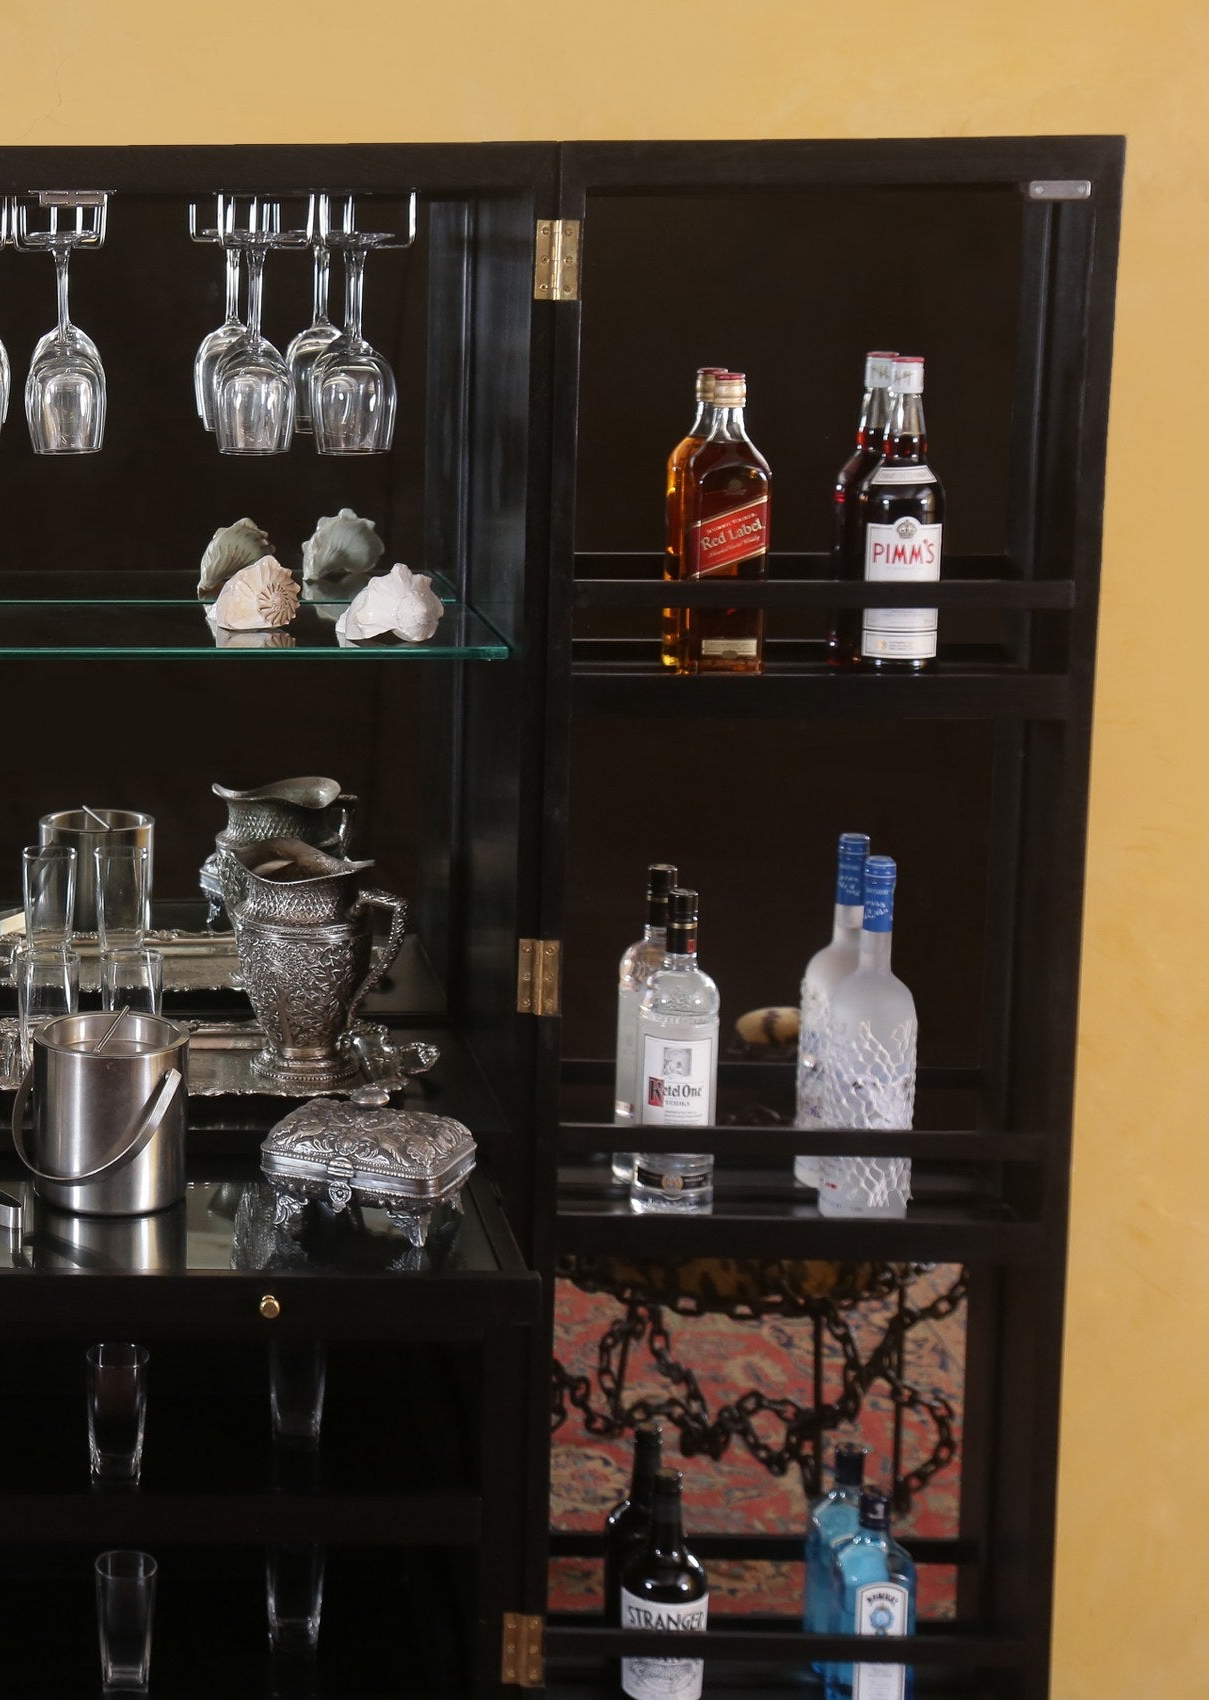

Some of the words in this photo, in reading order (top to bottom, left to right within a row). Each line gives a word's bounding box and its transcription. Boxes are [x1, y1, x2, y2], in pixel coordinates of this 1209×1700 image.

[701, 532, 727, 550] Red
[872, 539, 935, 565] PIMM'S
[649, 1079, 680, 1102] Ketel
[682, 1084, 703, 1098] One
